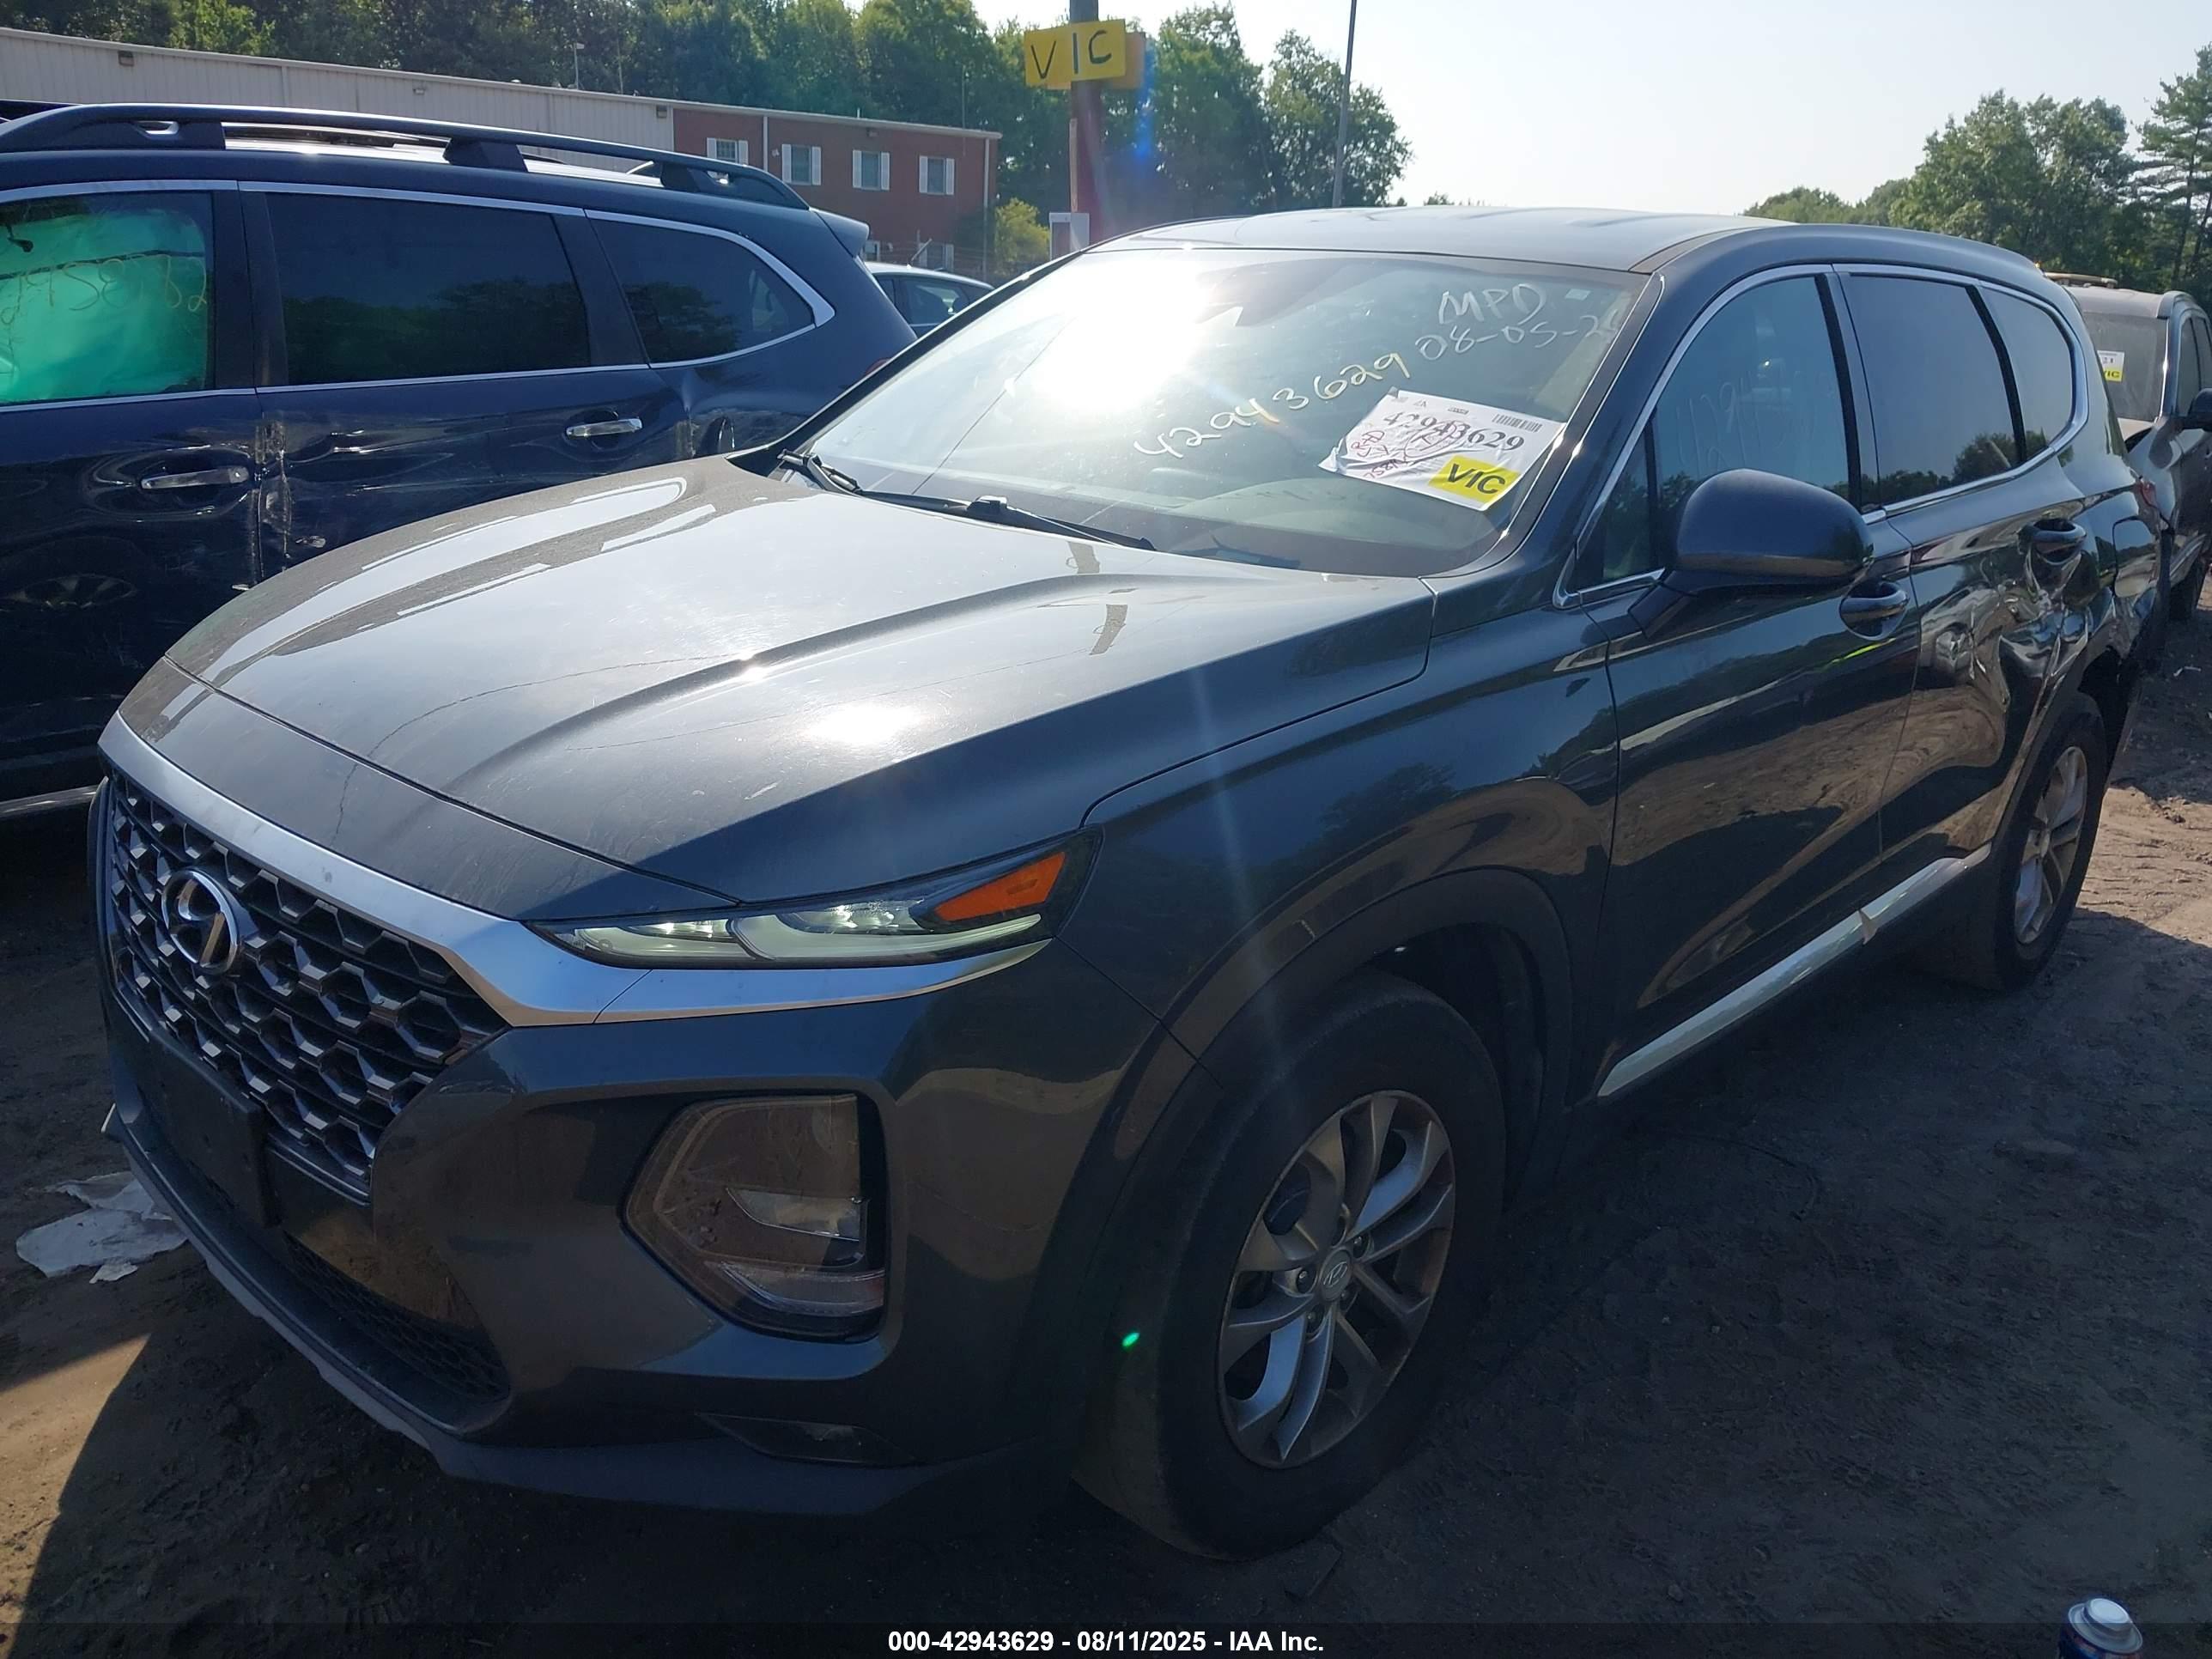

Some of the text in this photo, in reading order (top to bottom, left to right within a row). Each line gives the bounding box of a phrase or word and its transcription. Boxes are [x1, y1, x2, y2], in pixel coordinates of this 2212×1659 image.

[1030, 29, 1112, 79] VIC
[1438, 283, 1545, 325] MPD
[1133, 353, 1410, 459] 42943629
[1383, 412, 1525, 451] 42943629
[1447, 463, 1506, 495] VIC
